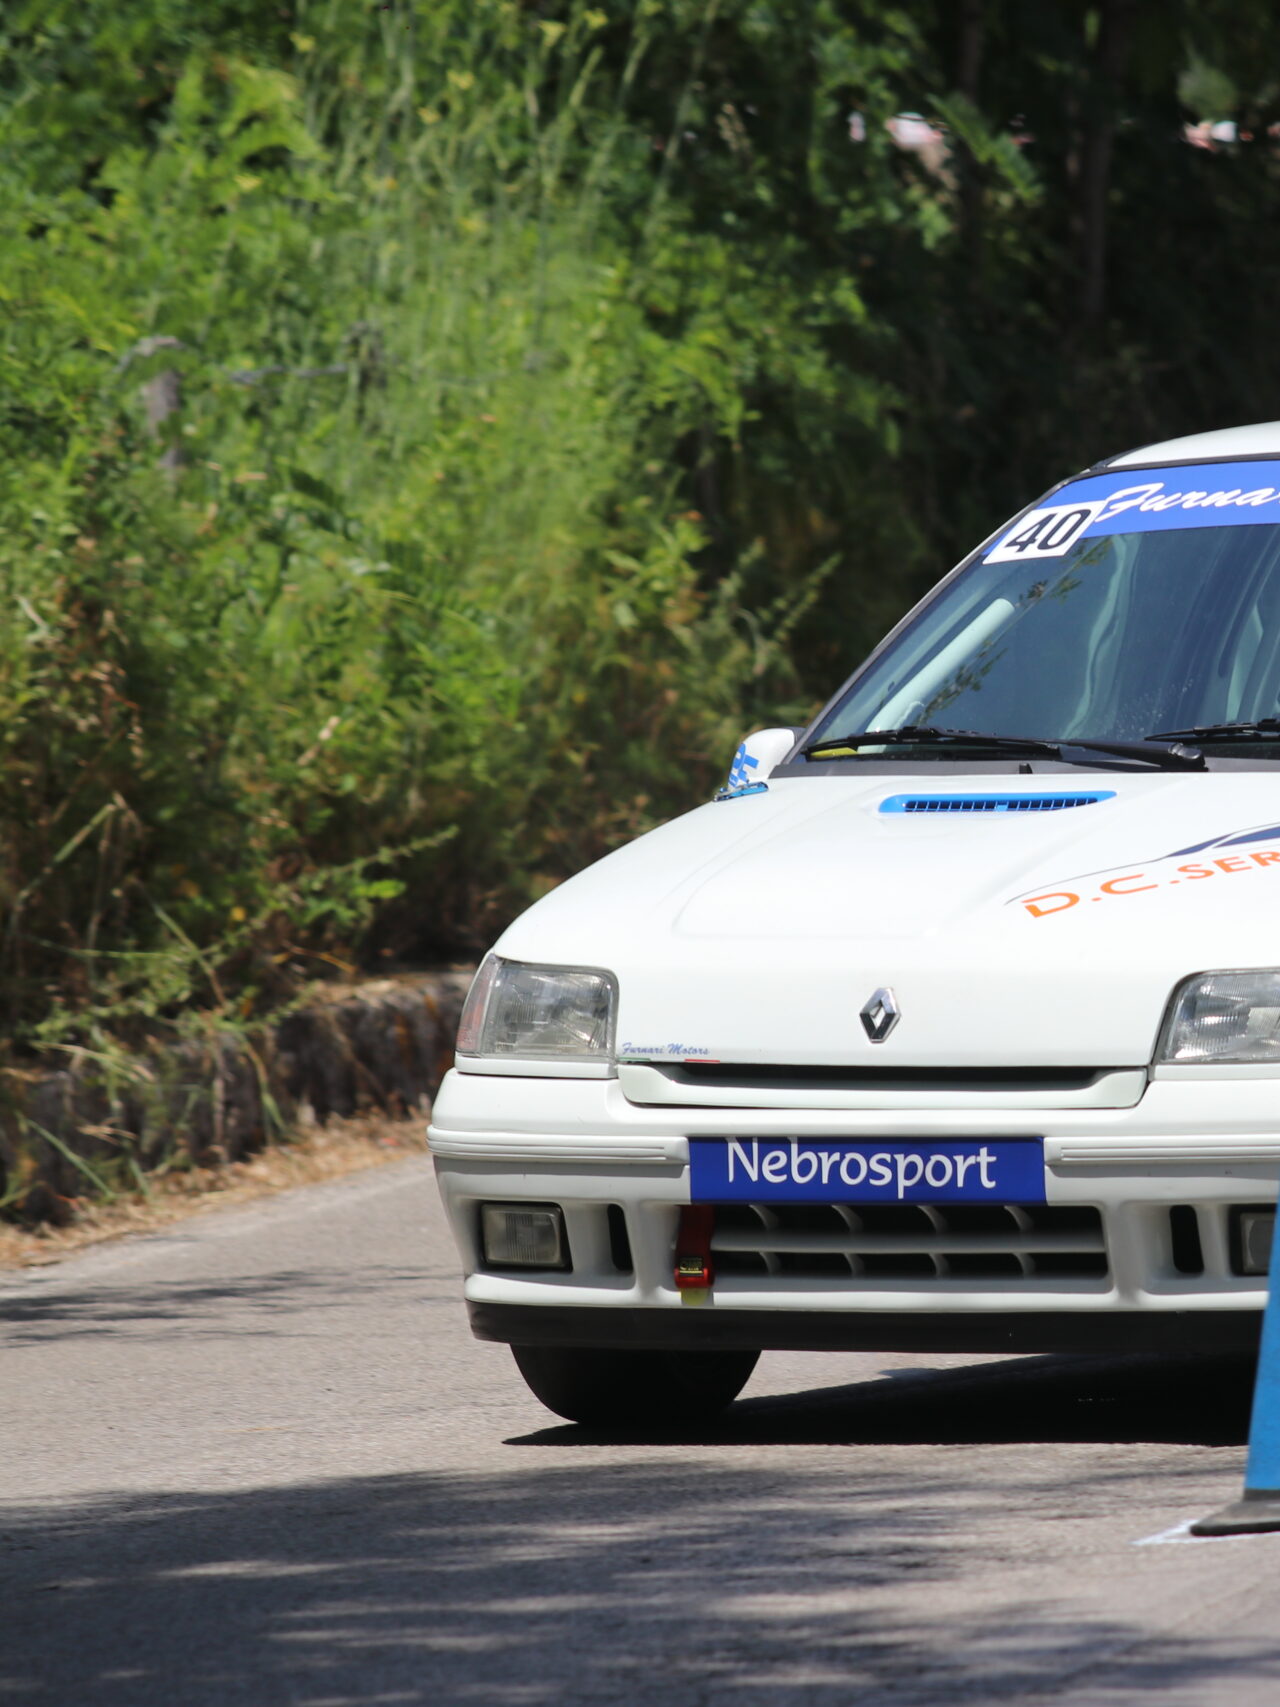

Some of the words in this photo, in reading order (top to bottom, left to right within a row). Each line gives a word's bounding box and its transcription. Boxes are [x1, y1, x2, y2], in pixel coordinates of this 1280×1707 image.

[1004, 509, 1092, 553] 40
[667, 1043, 709, 1055] Motors
[725, 1137, 998, 1199] Nebrosport
